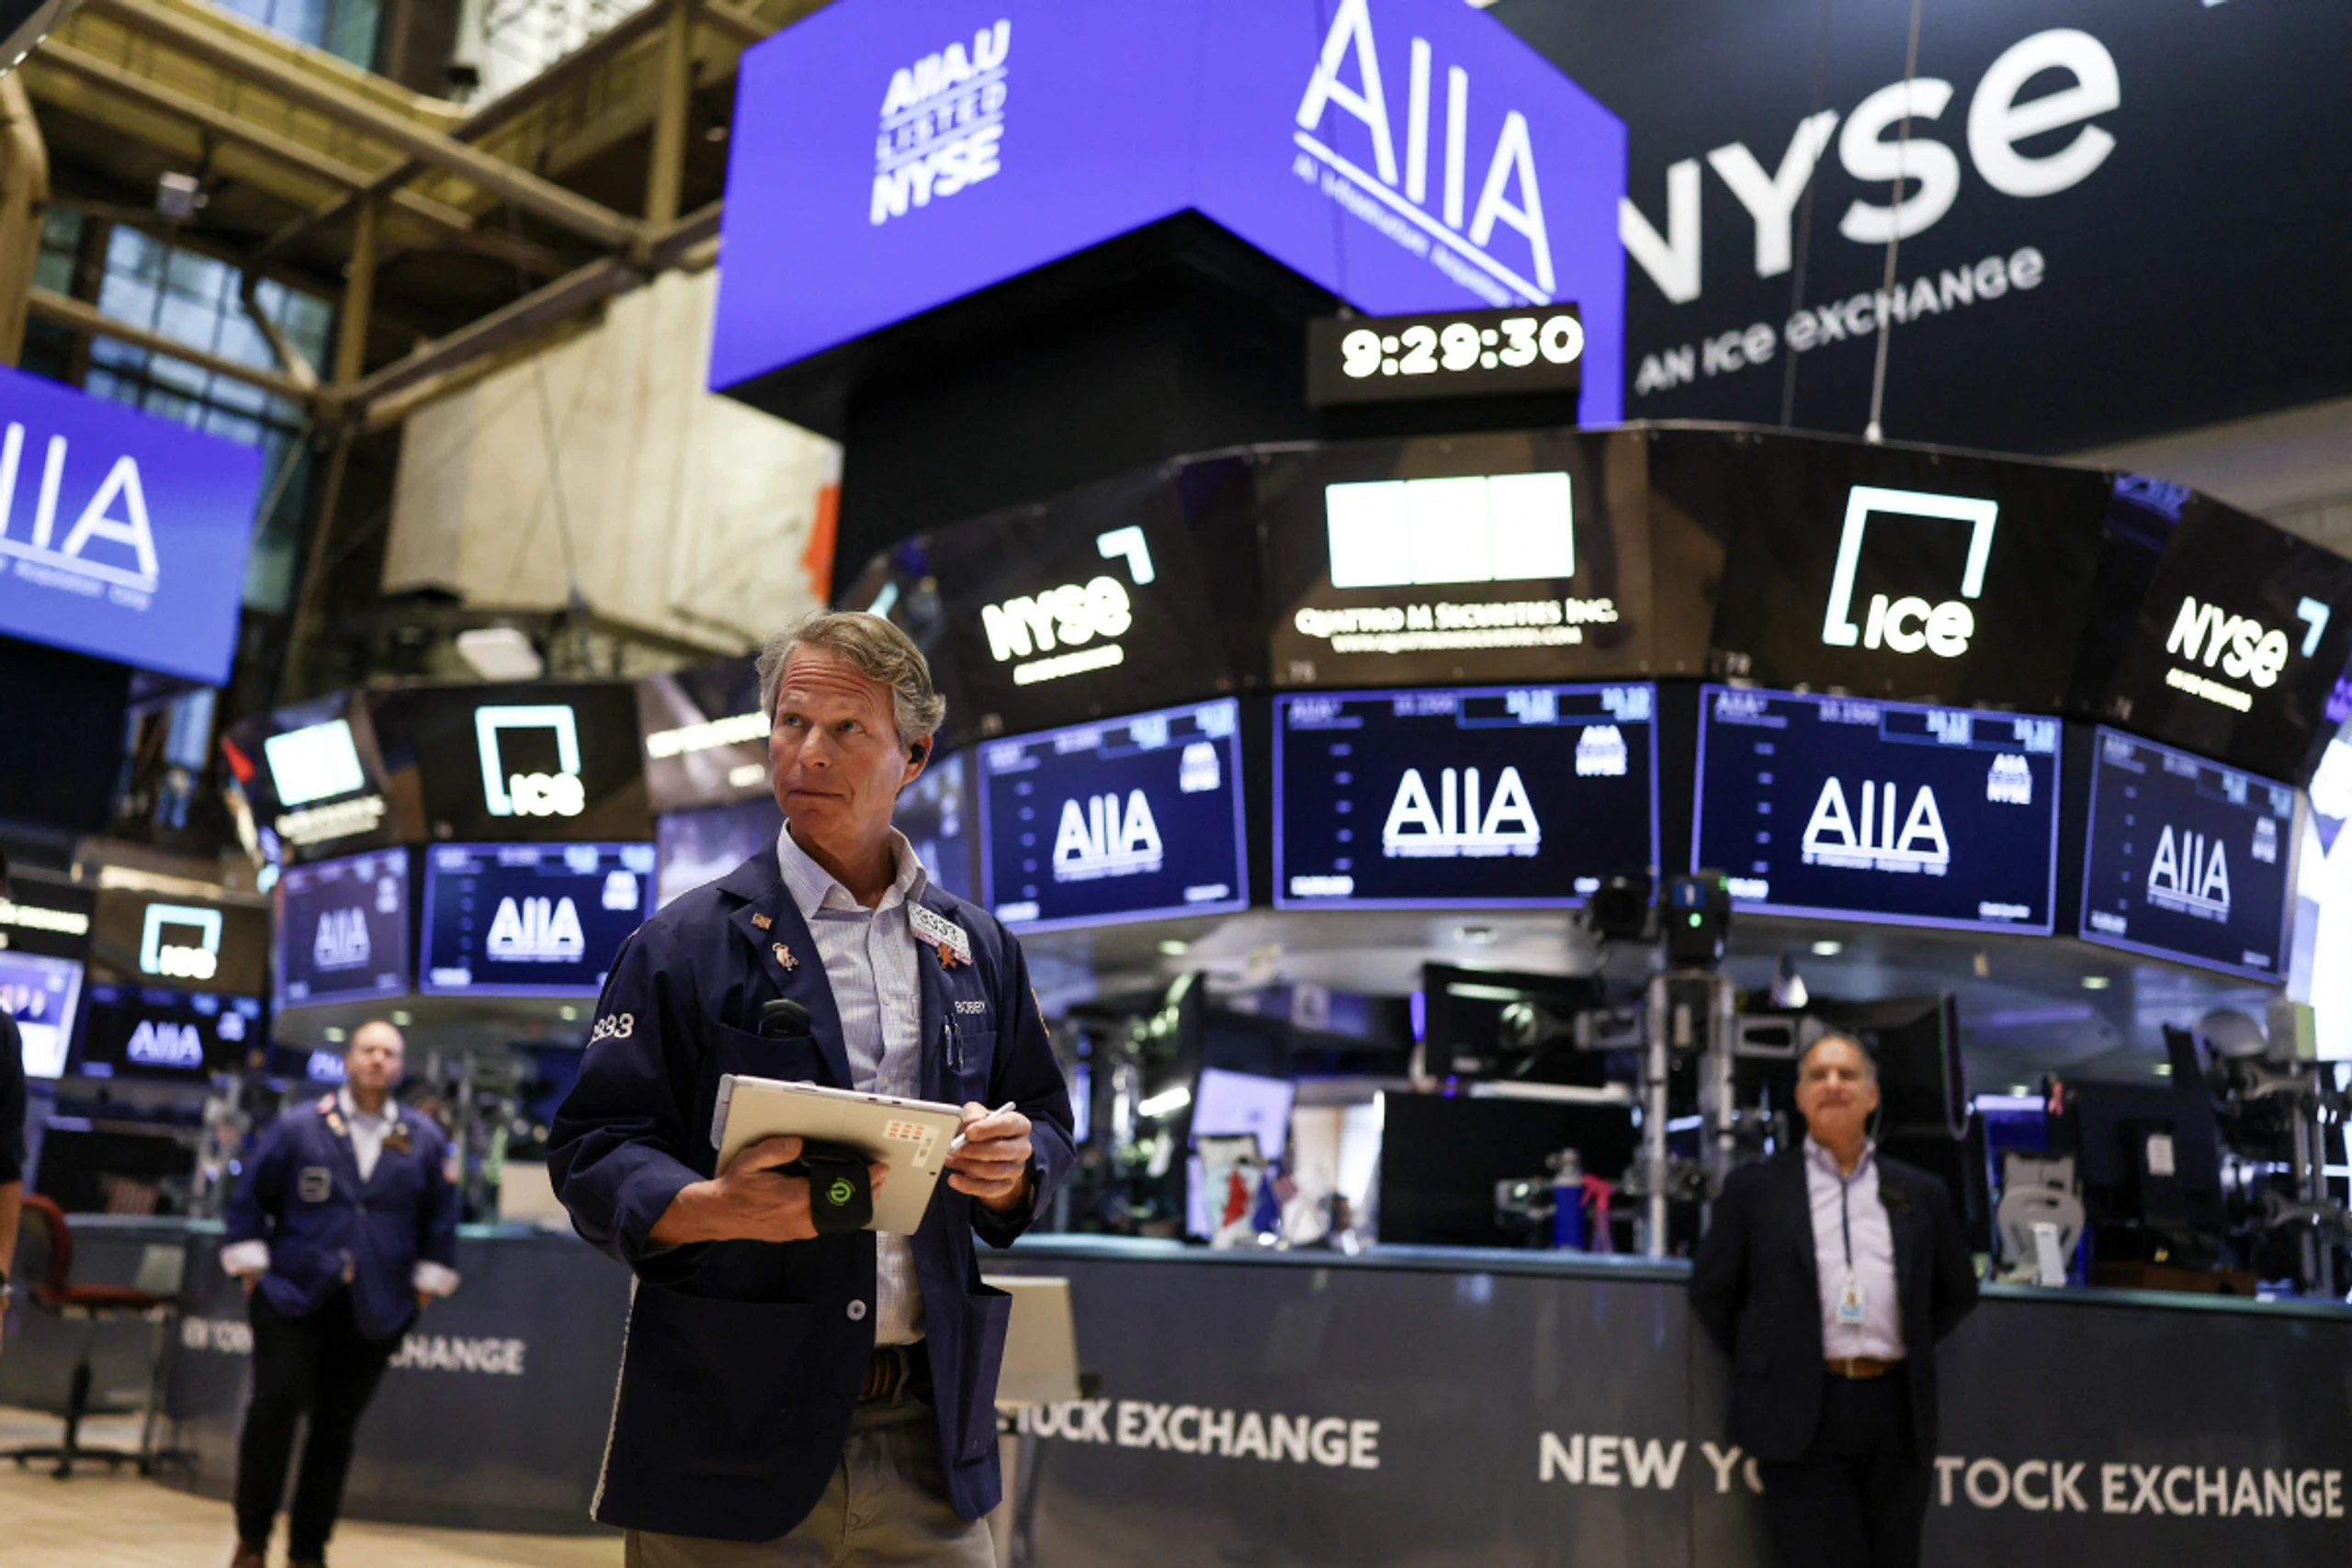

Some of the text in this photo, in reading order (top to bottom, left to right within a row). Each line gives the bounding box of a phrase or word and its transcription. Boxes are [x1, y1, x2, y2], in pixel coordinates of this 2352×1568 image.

[869, 123, 1004, 226] NYSE
[1341, 315, 1584, 378] 9:29:30
[1634, 344, 1694, 396] AN
[0, 421, 159, 580] IIA
[389, 1334, 526, 1375] HANGE
[996, 1397, 1380, 1469] TOCK EXCHANGE
[1539, 1431, 1688, 1490] NEW
[1933, 1455, 2344, 1518] TOCK EXCHANGE
